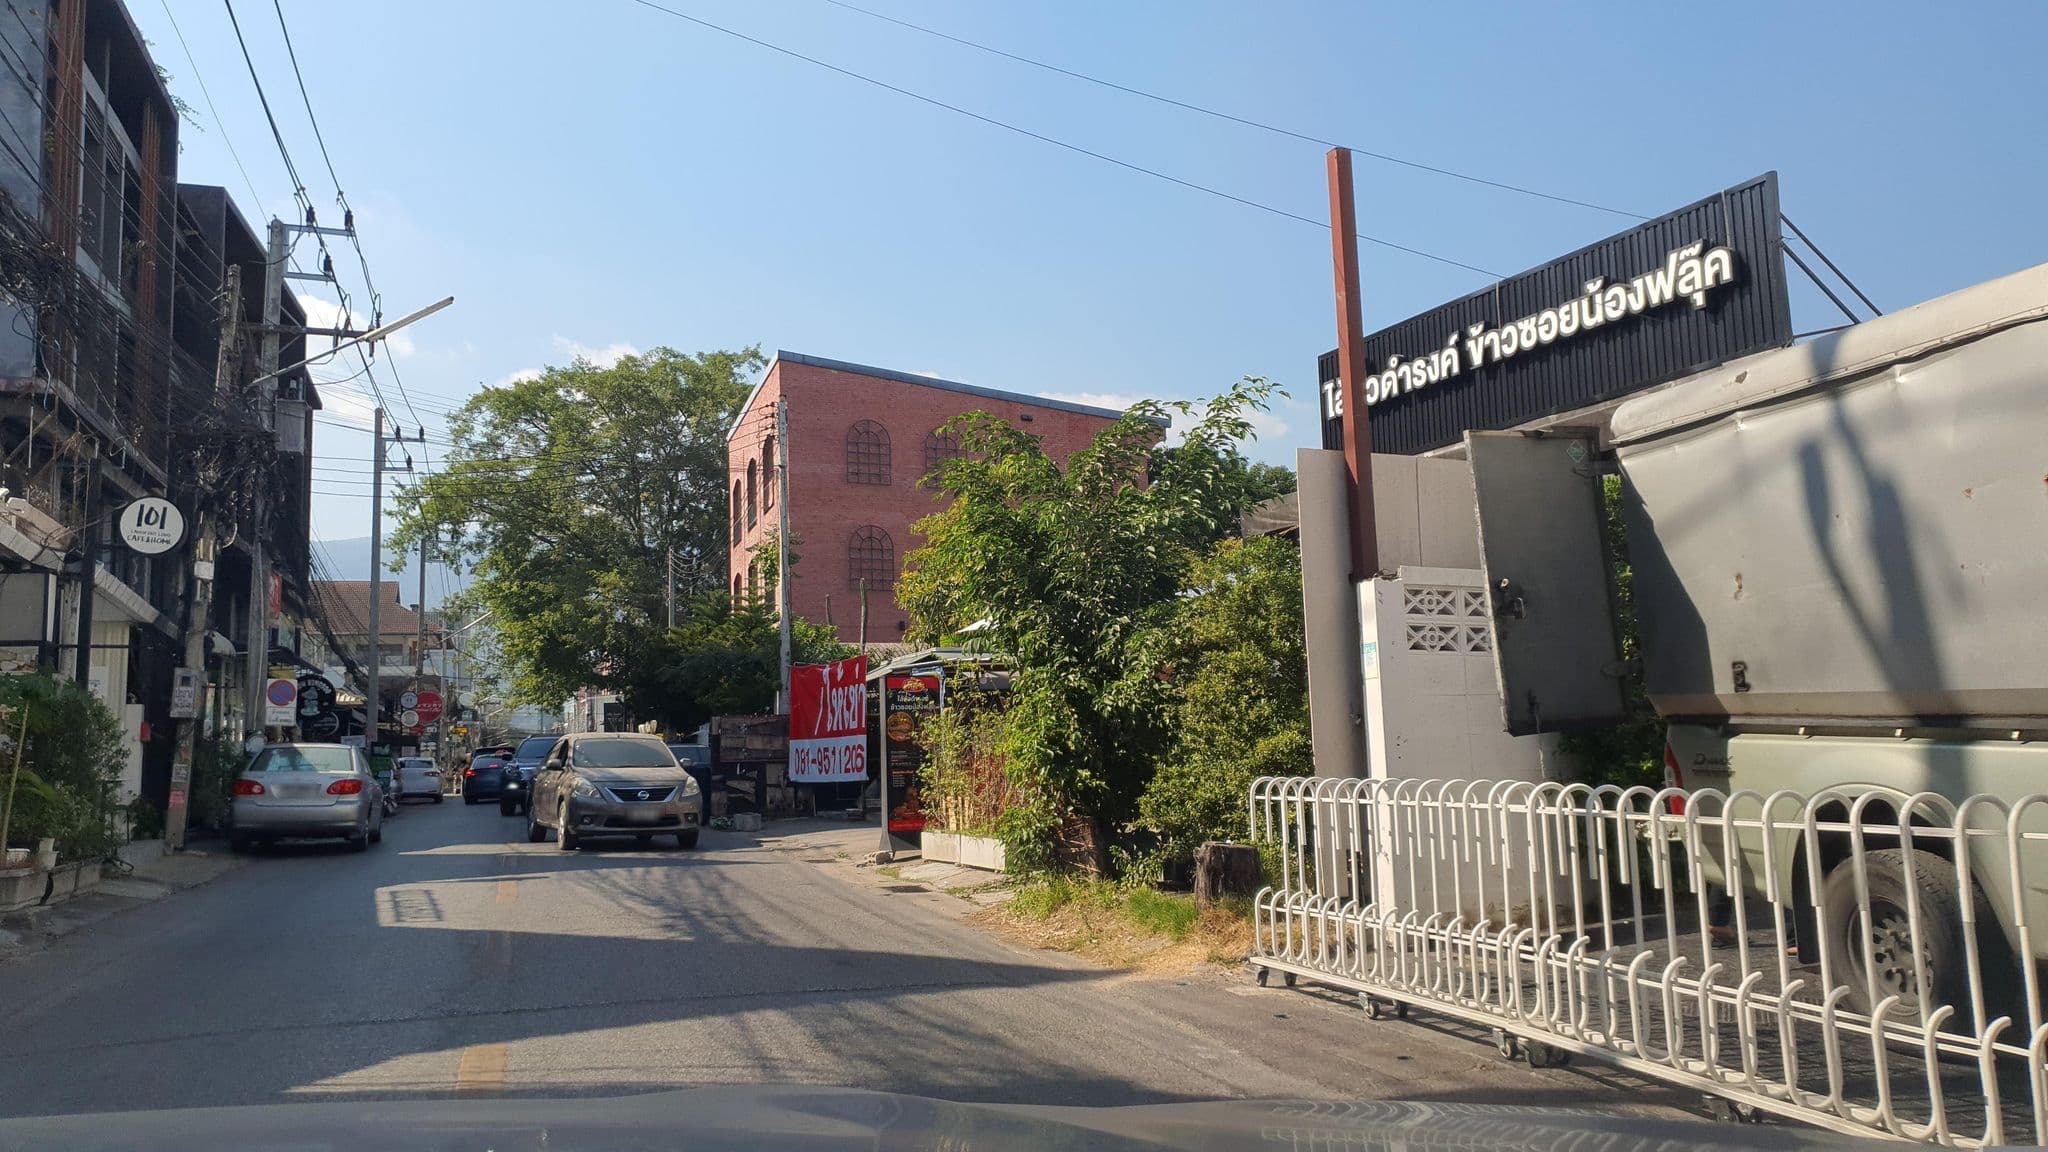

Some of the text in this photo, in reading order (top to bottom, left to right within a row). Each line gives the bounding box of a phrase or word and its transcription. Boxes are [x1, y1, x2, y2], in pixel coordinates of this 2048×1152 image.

[1466, 240, 1735, 369] ข้าวซอยน้องฟลุ๊ค
